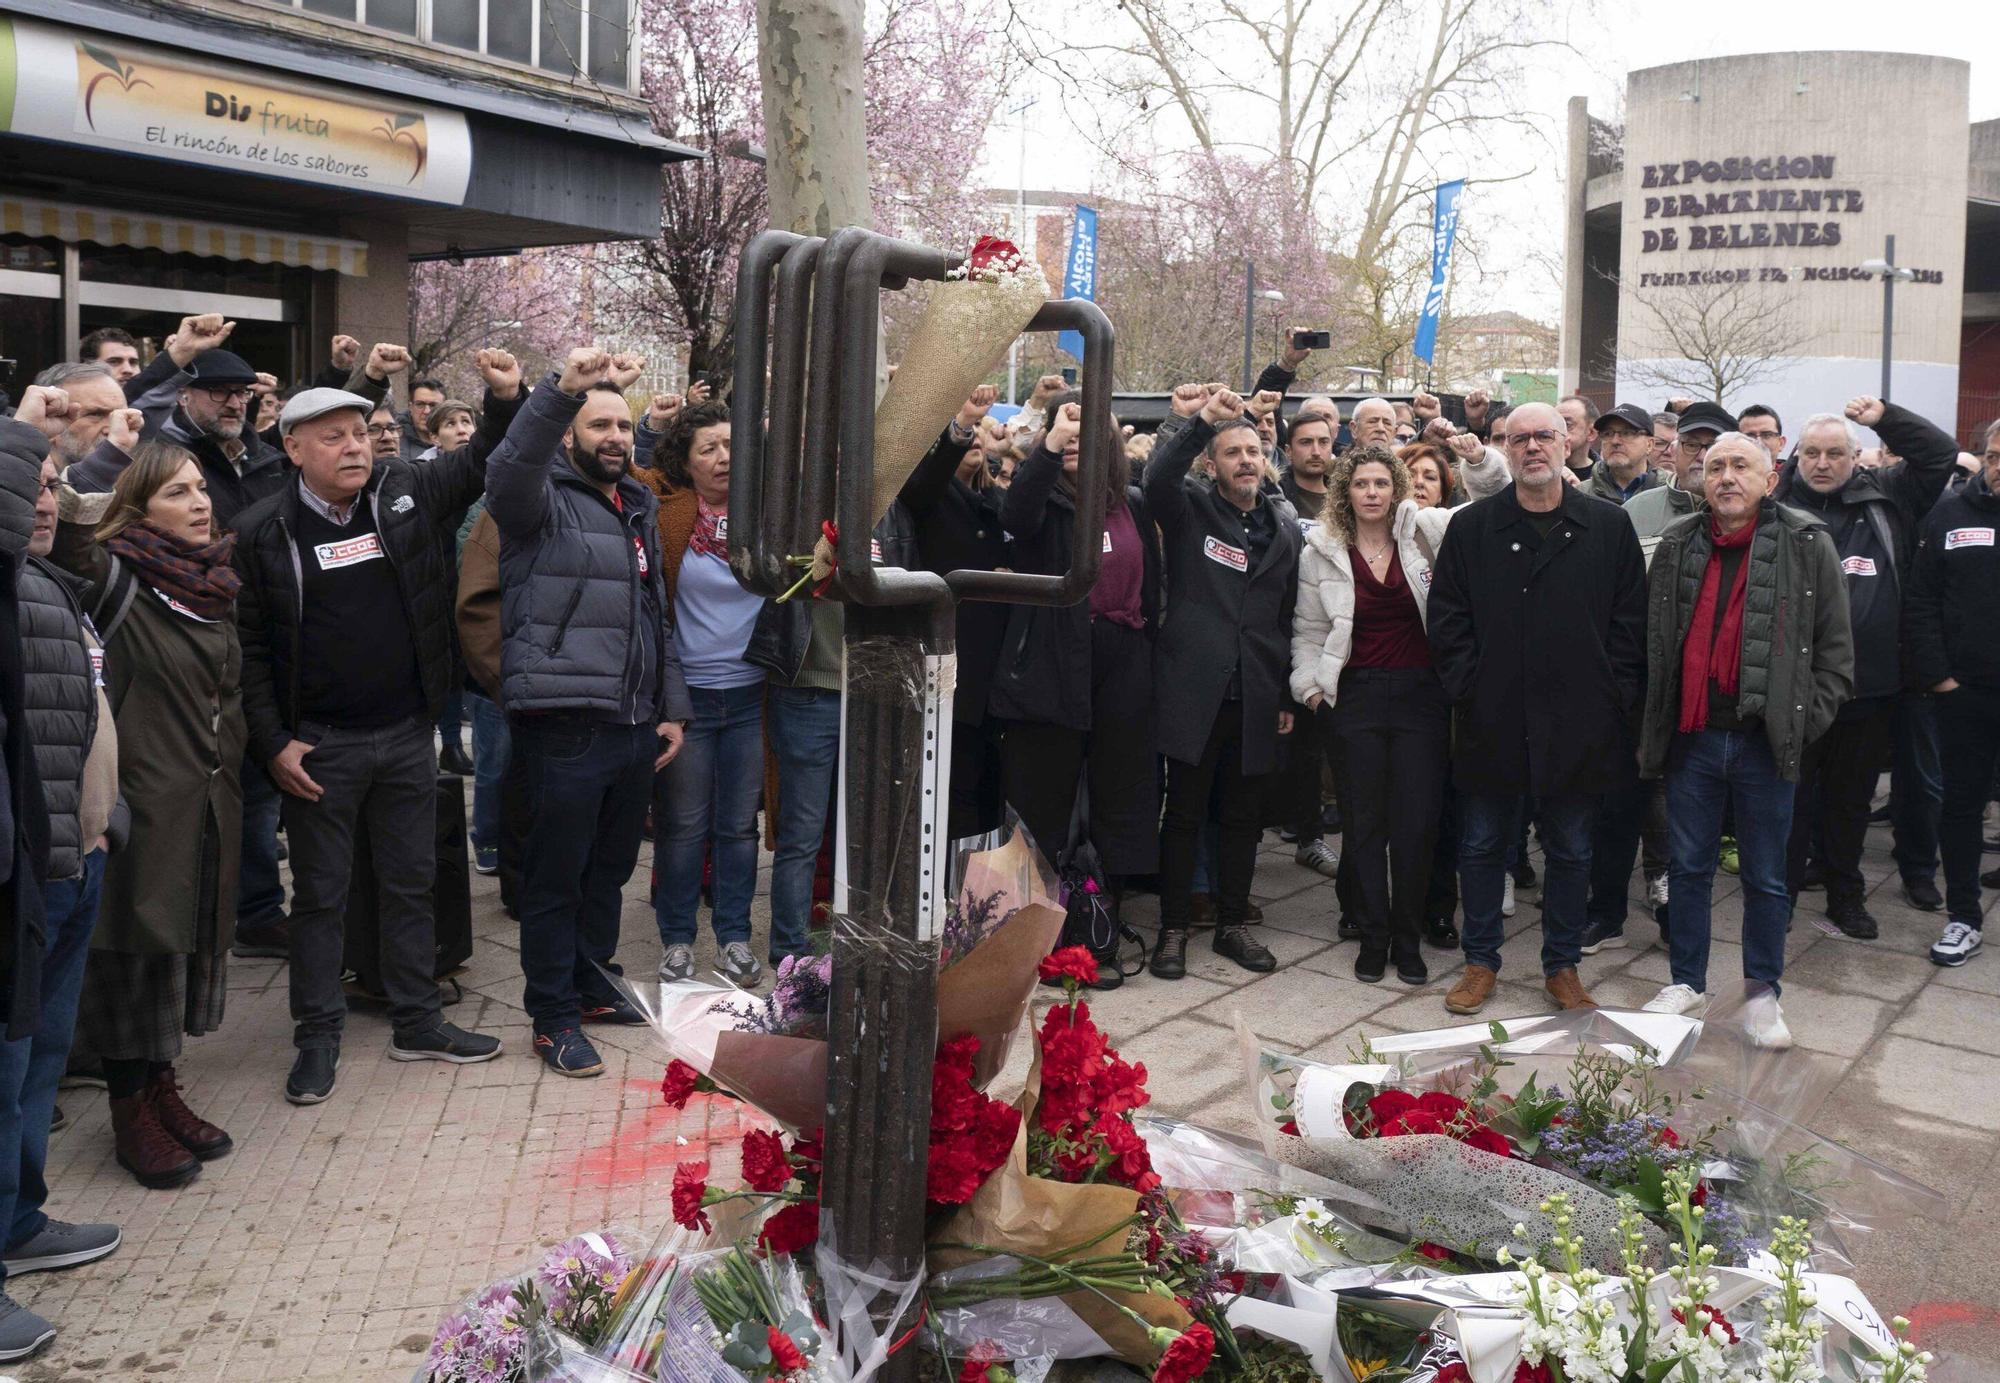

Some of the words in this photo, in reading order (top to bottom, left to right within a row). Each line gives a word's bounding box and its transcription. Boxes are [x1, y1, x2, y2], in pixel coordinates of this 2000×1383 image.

[205, 91, 251, 122] Dis
[258, 102, 329, 137] fruta
[146, 127, 166, 143] El
[174, 136, 241, 156] rincón
[247, 144, 267, 161] de
[273, 147, 298, 166] los
[304, 155, 369, 178] sabores
[1641, 155, 1836, 188] EXPOSICION
[1644, 189, 1864, 219] PERMANENTE
[1641, 227, 1678, 254] DE
[1688, 222, 1842, 250] BELENES
[1639, 268, 1750, 288] FUNDACION
[1758, 266, 1873, 283] FRNCISCO
